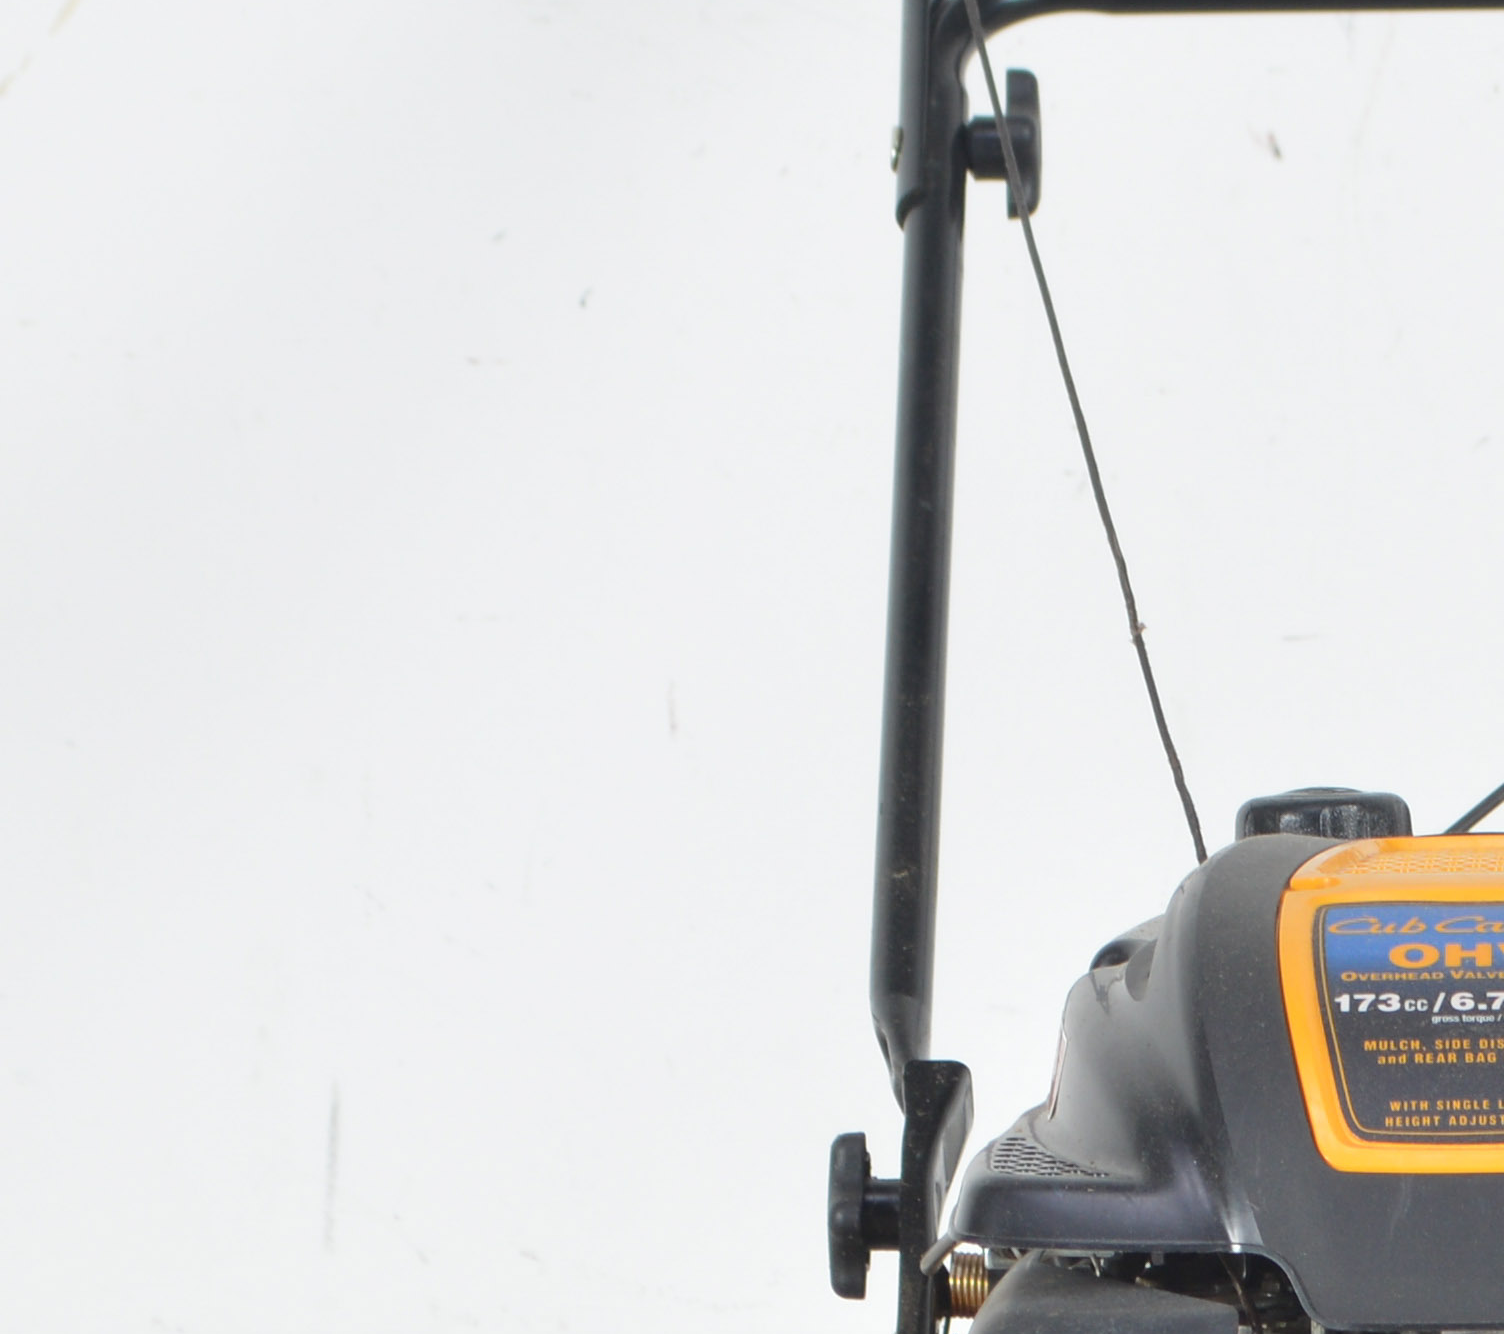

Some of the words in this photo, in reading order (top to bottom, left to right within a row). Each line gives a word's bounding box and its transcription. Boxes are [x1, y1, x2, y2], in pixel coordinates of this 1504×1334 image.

[1327, 916, 1427, 935] Cub
[1340, 971, 1445, 982] OVERHEAD
[1432, 1014, 1460, 1025] gross
[1364, 1040, 1427, 1052] MULCH,
[1435, 1039, 1471, 1050] SIDE
[1378, 1053, 1407, 1065] and
[1414, 1052, 1457, 1064] REAR
[1465, 1052, 1497, 1063] BAG
[1389, 1100, 1429, 1111] WITH
[1436, 1099, 1490, 1110] SINGLE
[1385, 1116, 1440, 1128] HEIGHT
